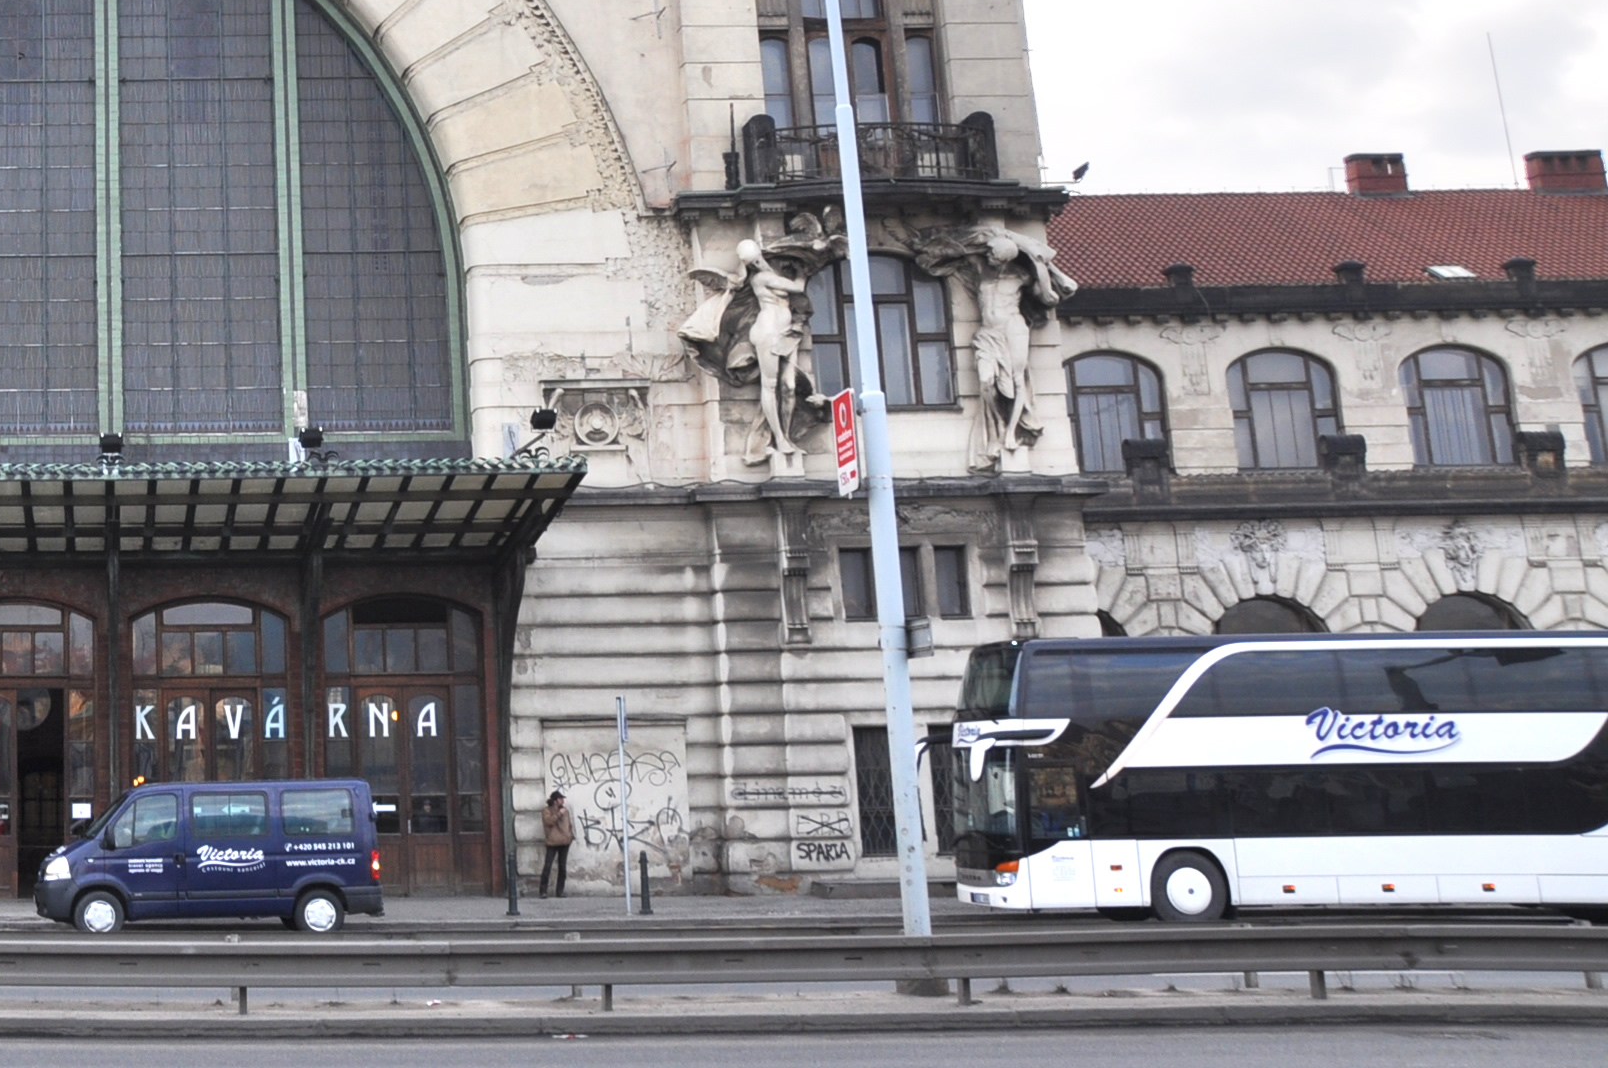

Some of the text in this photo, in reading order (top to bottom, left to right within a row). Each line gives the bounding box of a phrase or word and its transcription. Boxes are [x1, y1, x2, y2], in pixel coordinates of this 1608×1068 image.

[135, 696, 438, 741] KAVÁRNA
[1305, 707, 1460, 741] Victoria
[196, 844, 265, 861] Victoria
[796, 842, 850, 862] SPARTA
